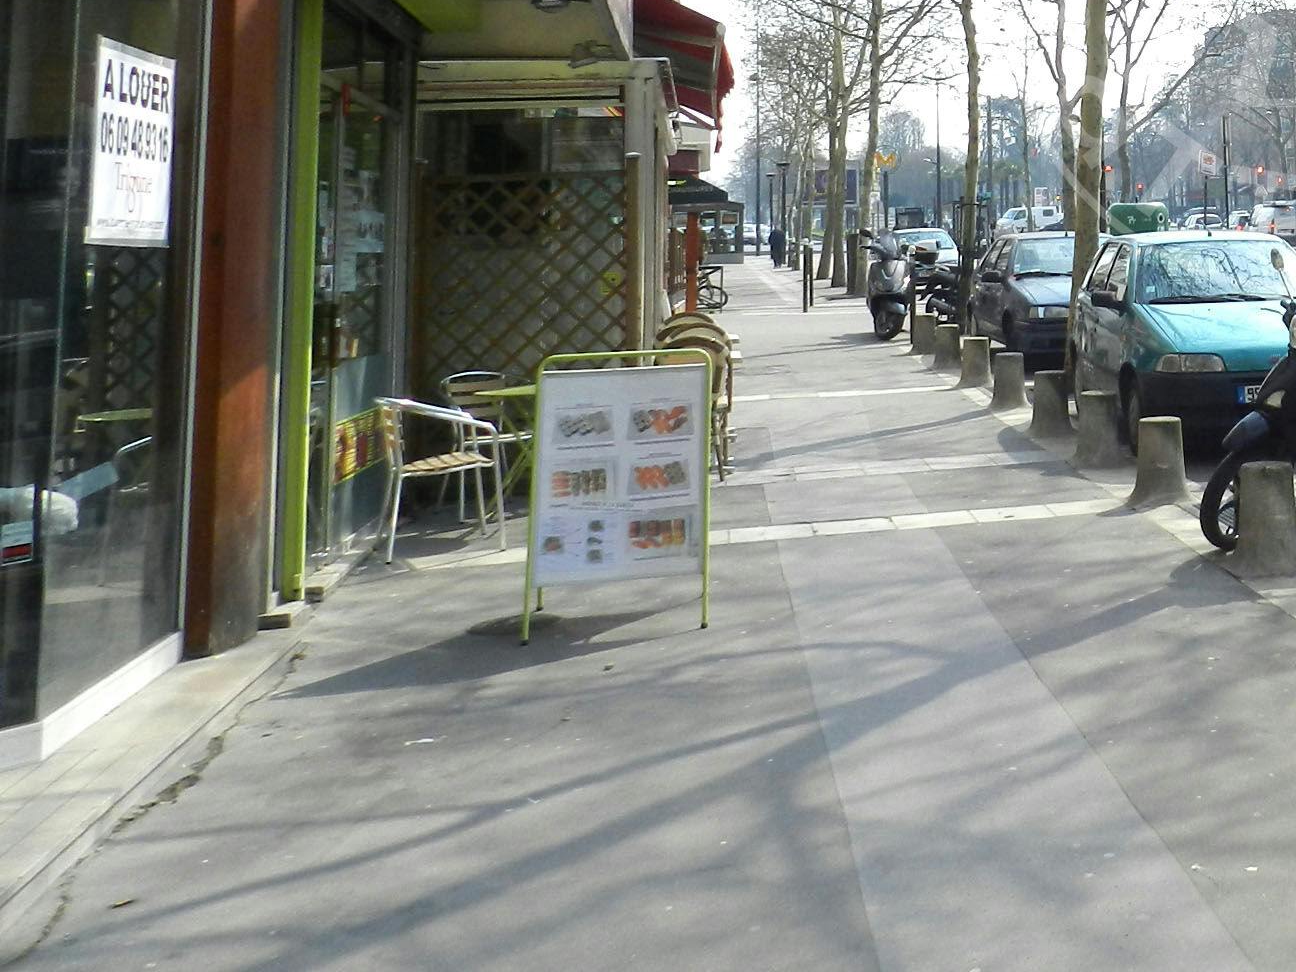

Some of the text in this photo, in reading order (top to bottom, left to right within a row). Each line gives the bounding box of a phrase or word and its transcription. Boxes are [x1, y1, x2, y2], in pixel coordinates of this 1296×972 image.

[103, 59, 169, 113] A LOUER
[101, 111, 168, 163] 06 09 48 93 16
